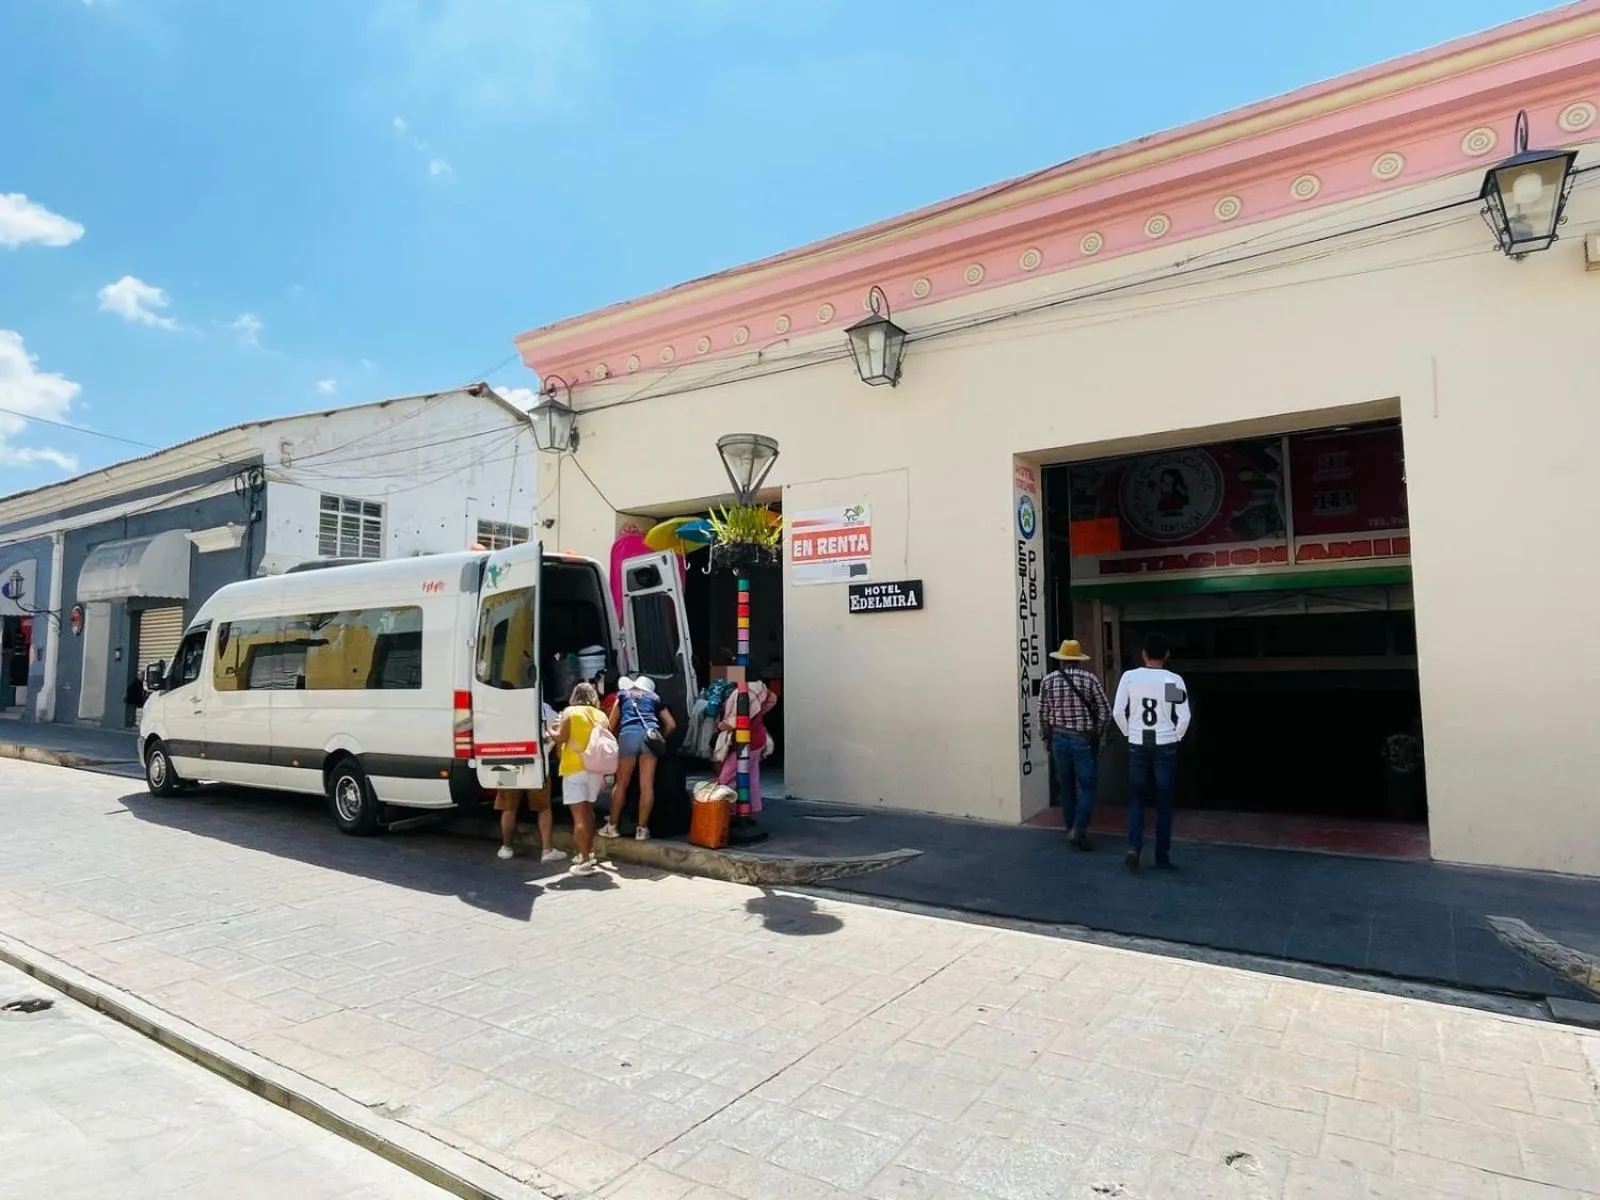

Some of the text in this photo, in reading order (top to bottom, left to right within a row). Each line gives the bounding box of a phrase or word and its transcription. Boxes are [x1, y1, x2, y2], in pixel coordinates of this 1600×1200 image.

[793, 534, 869, 557] EN RENTA
[849, 590, 918, 611] EDELMIRA
[864, 584, 901, 595] HOTEL
[1027, 550, 1040, 667] PUBLICO
[1017, 539, 1033, 776] ESTACIONAMIENTO
[1141, 697, 1158, 727] 8
